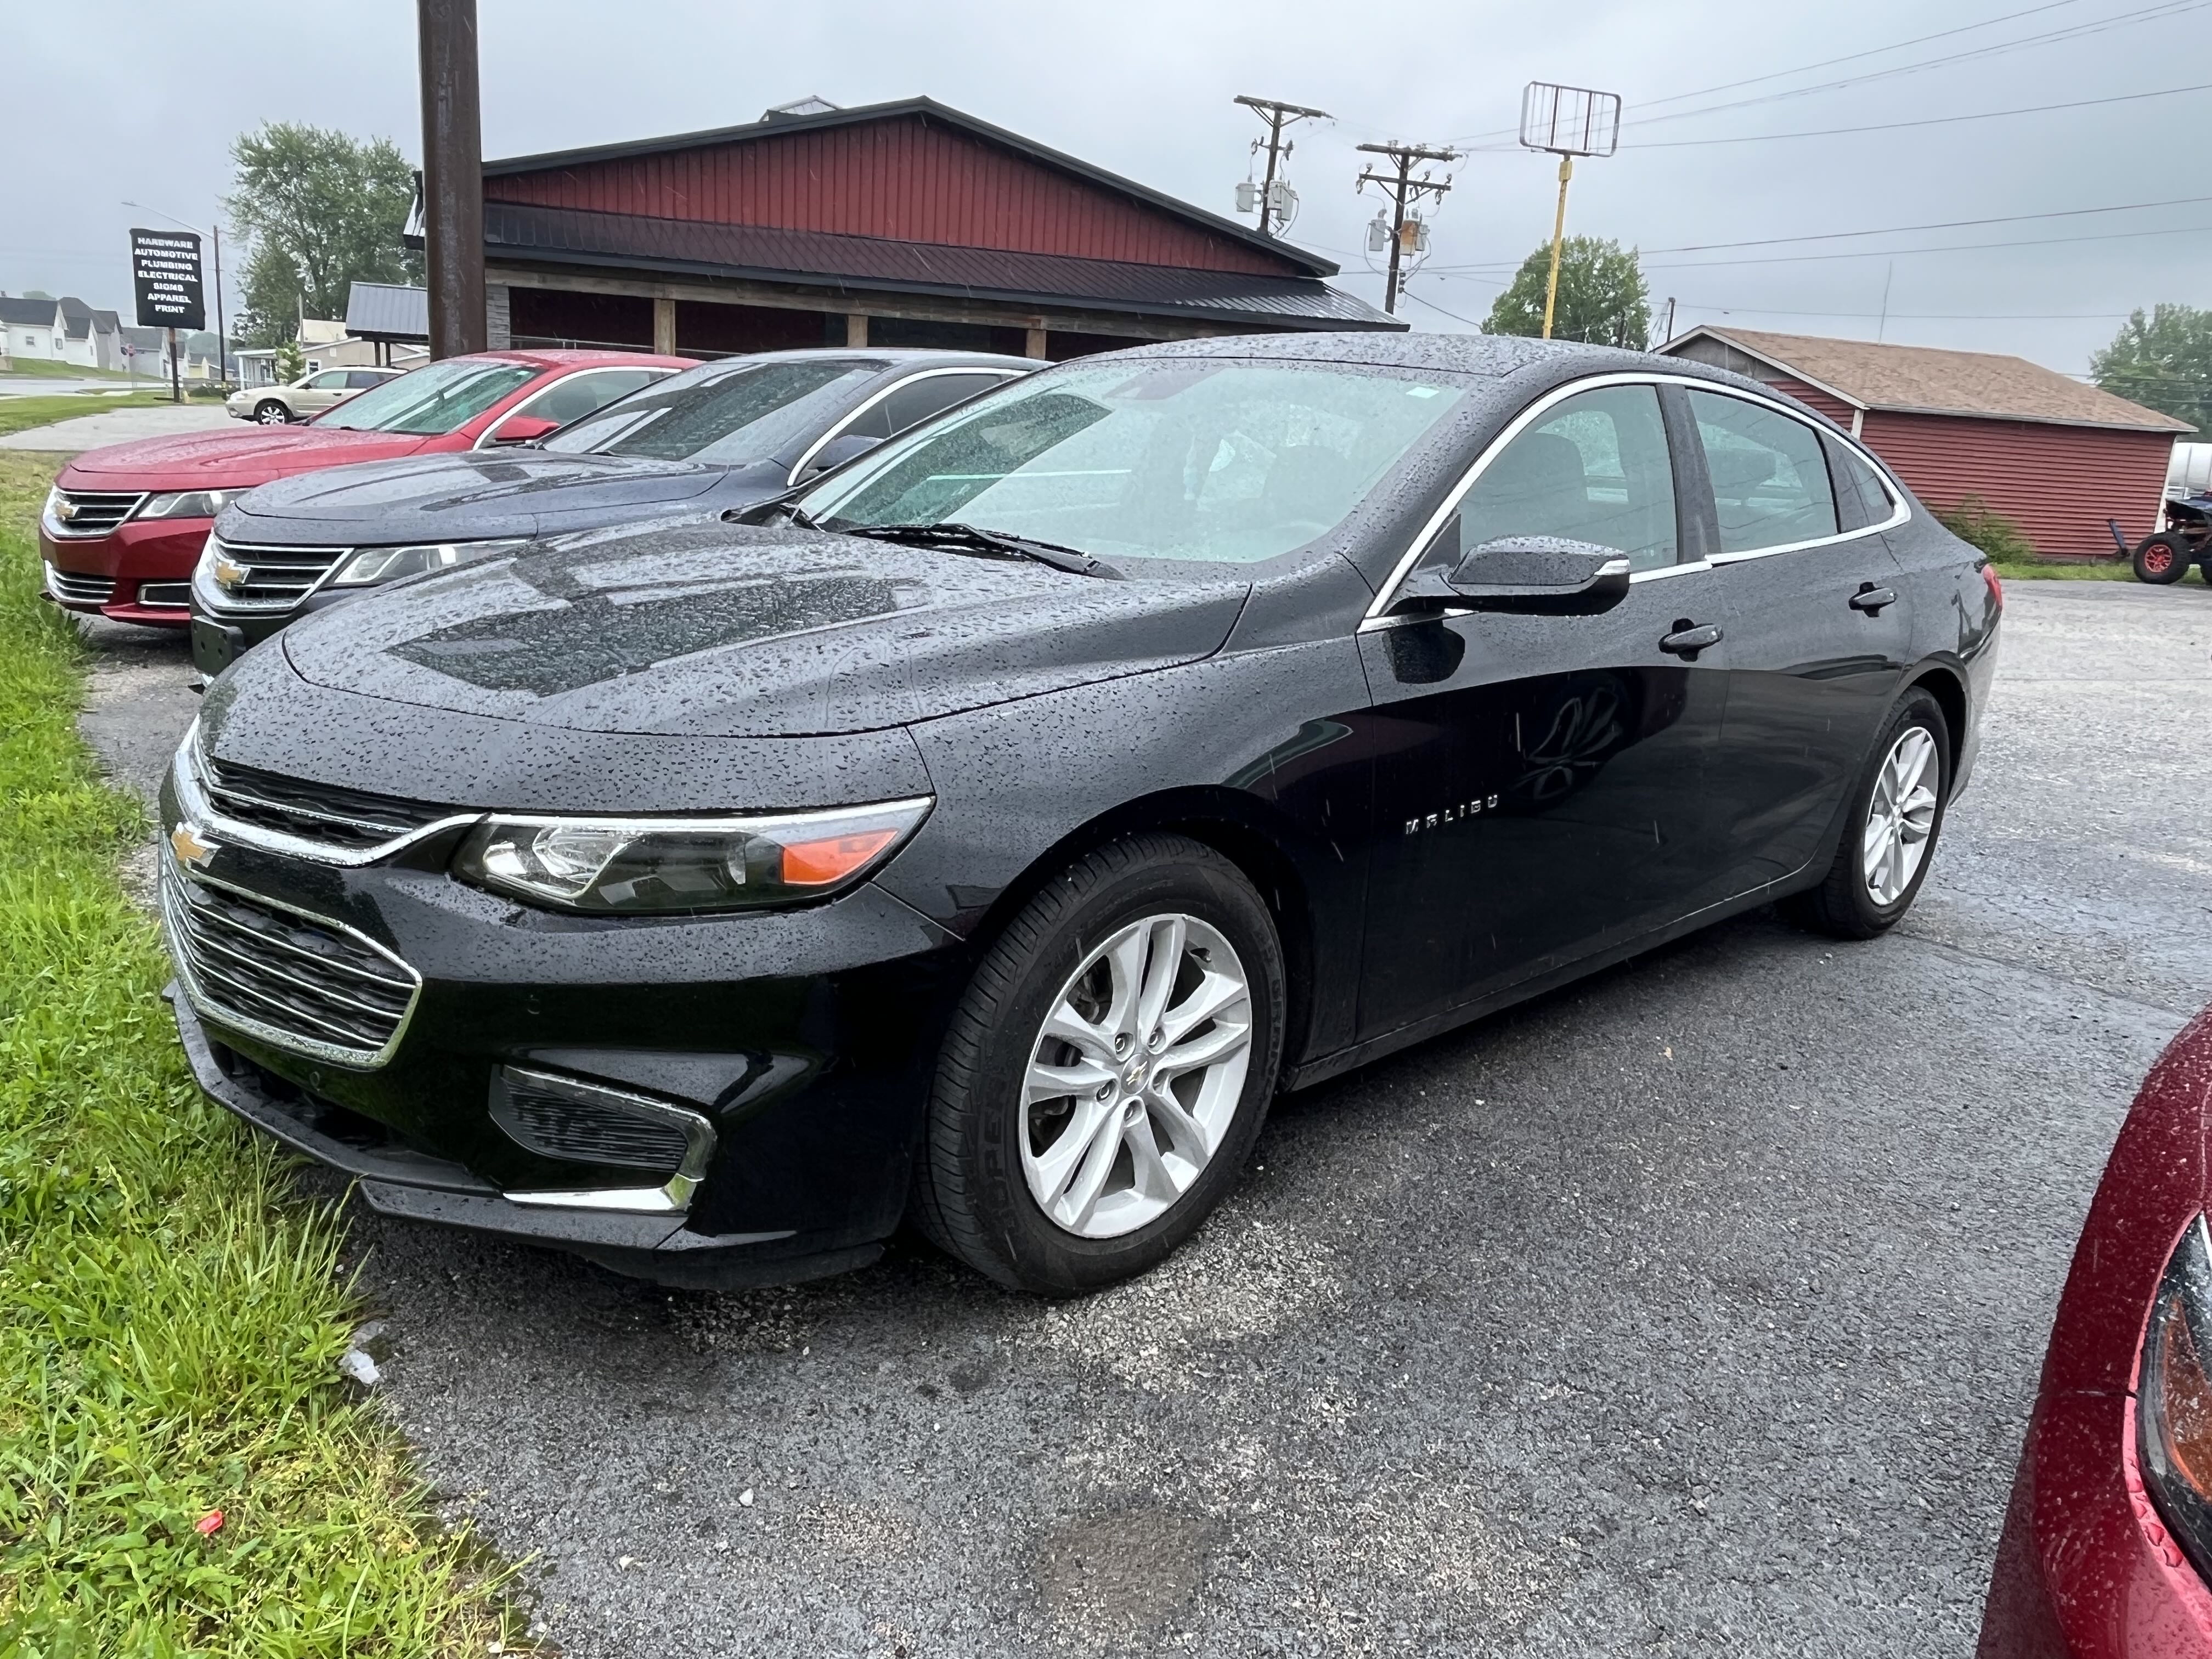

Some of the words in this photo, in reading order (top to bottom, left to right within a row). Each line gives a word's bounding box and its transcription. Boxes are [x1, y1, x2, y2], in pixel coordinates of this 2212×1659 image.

[137, 237, 193, 249] HARDWARE
[134, 248, 198, 261] AUTOMOTIVE
[141, 259, 193, 270] PLUMBING
[138, 270, 198, 282] ELECTRICAL
[153, 282, 184, 292] SIGNS
[147, 293, 192, 303] APPAREL
[155, 304, 185, 313] PRINT
[1406, 794, 1498, 834] MALIBU
